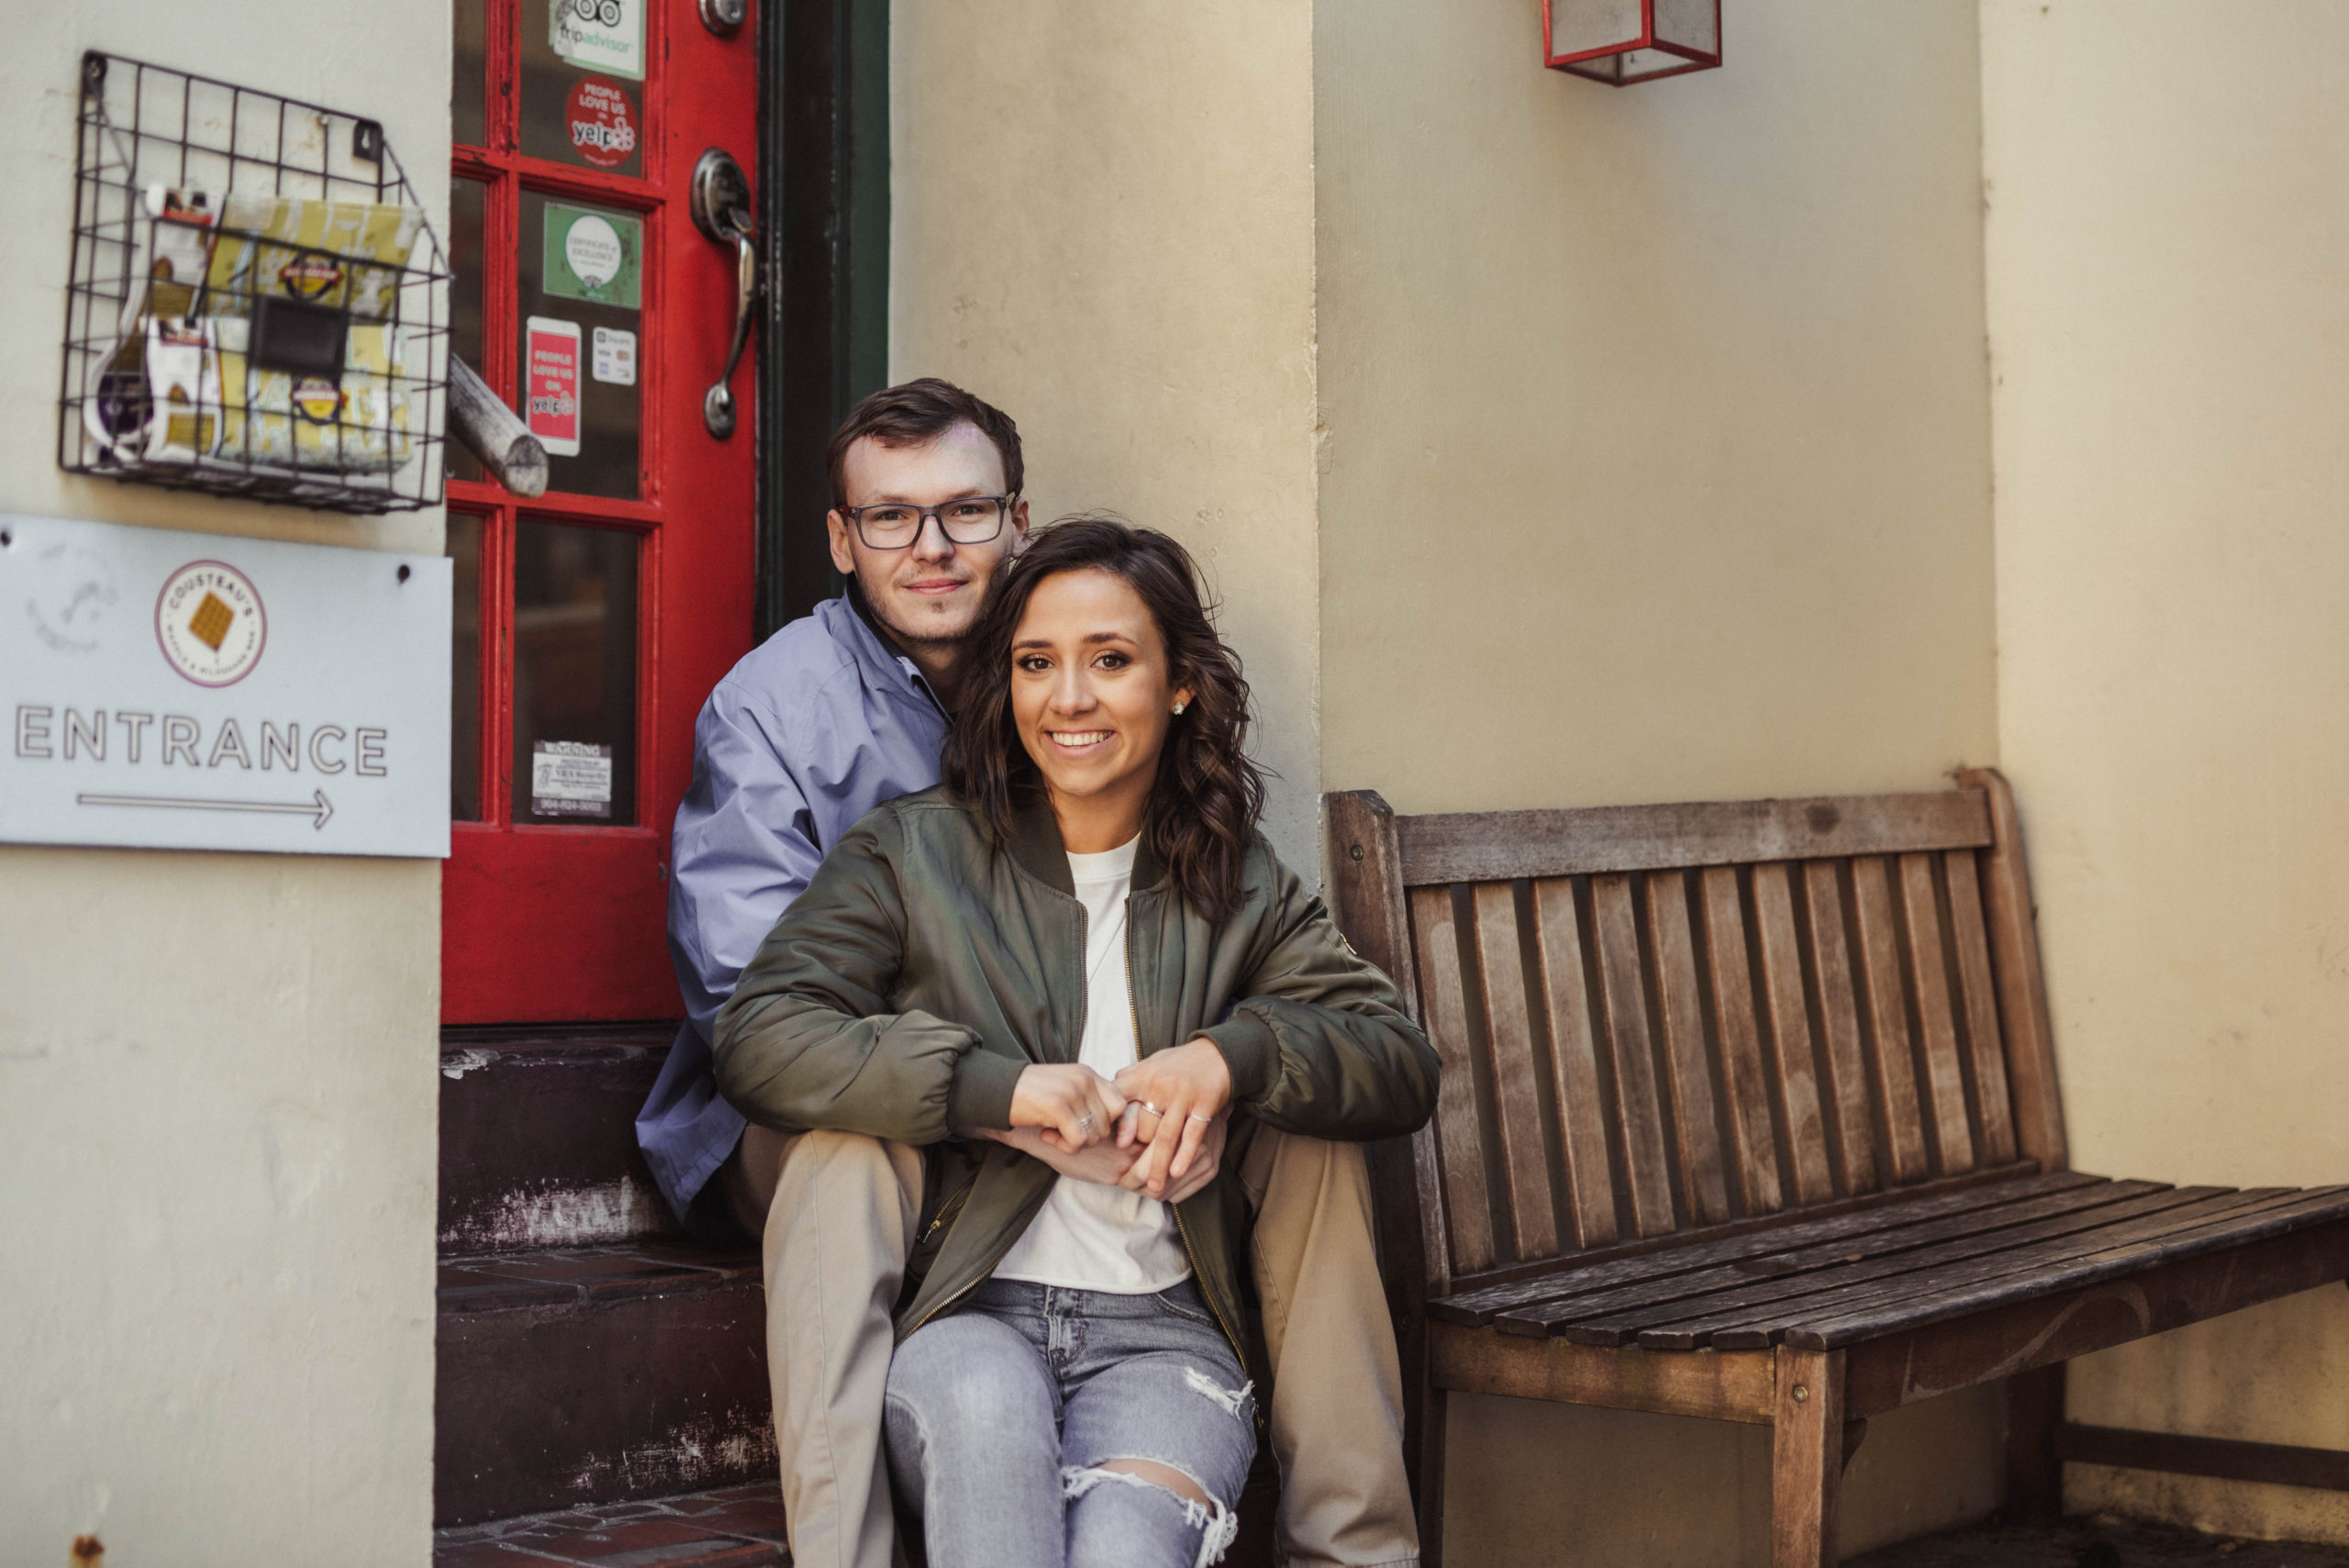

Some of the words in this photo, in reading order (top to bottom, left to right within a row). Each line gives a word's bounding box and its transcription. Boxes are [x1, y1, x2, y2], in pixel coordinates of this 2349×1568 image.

[560, 24, 631, 53] tripadvisor
[584, 83, 620, 101] PEOPLE
[579, 94, 608, 111] LOVE
[610, 101, 626, 116] US
[573, 122, 613, 150] yelp
[535, 350, 572, 365] PEOPLE
[533, 364, 559, 378] LOVE
[560, 368, 573, 380] US
[546, 380, 561, 392] ON
[169, 573, 253, 617] COUSTEAU'S
[15, 705, 387, 777] ENTRANCE
[544, 741, 601, 758] WARNING
